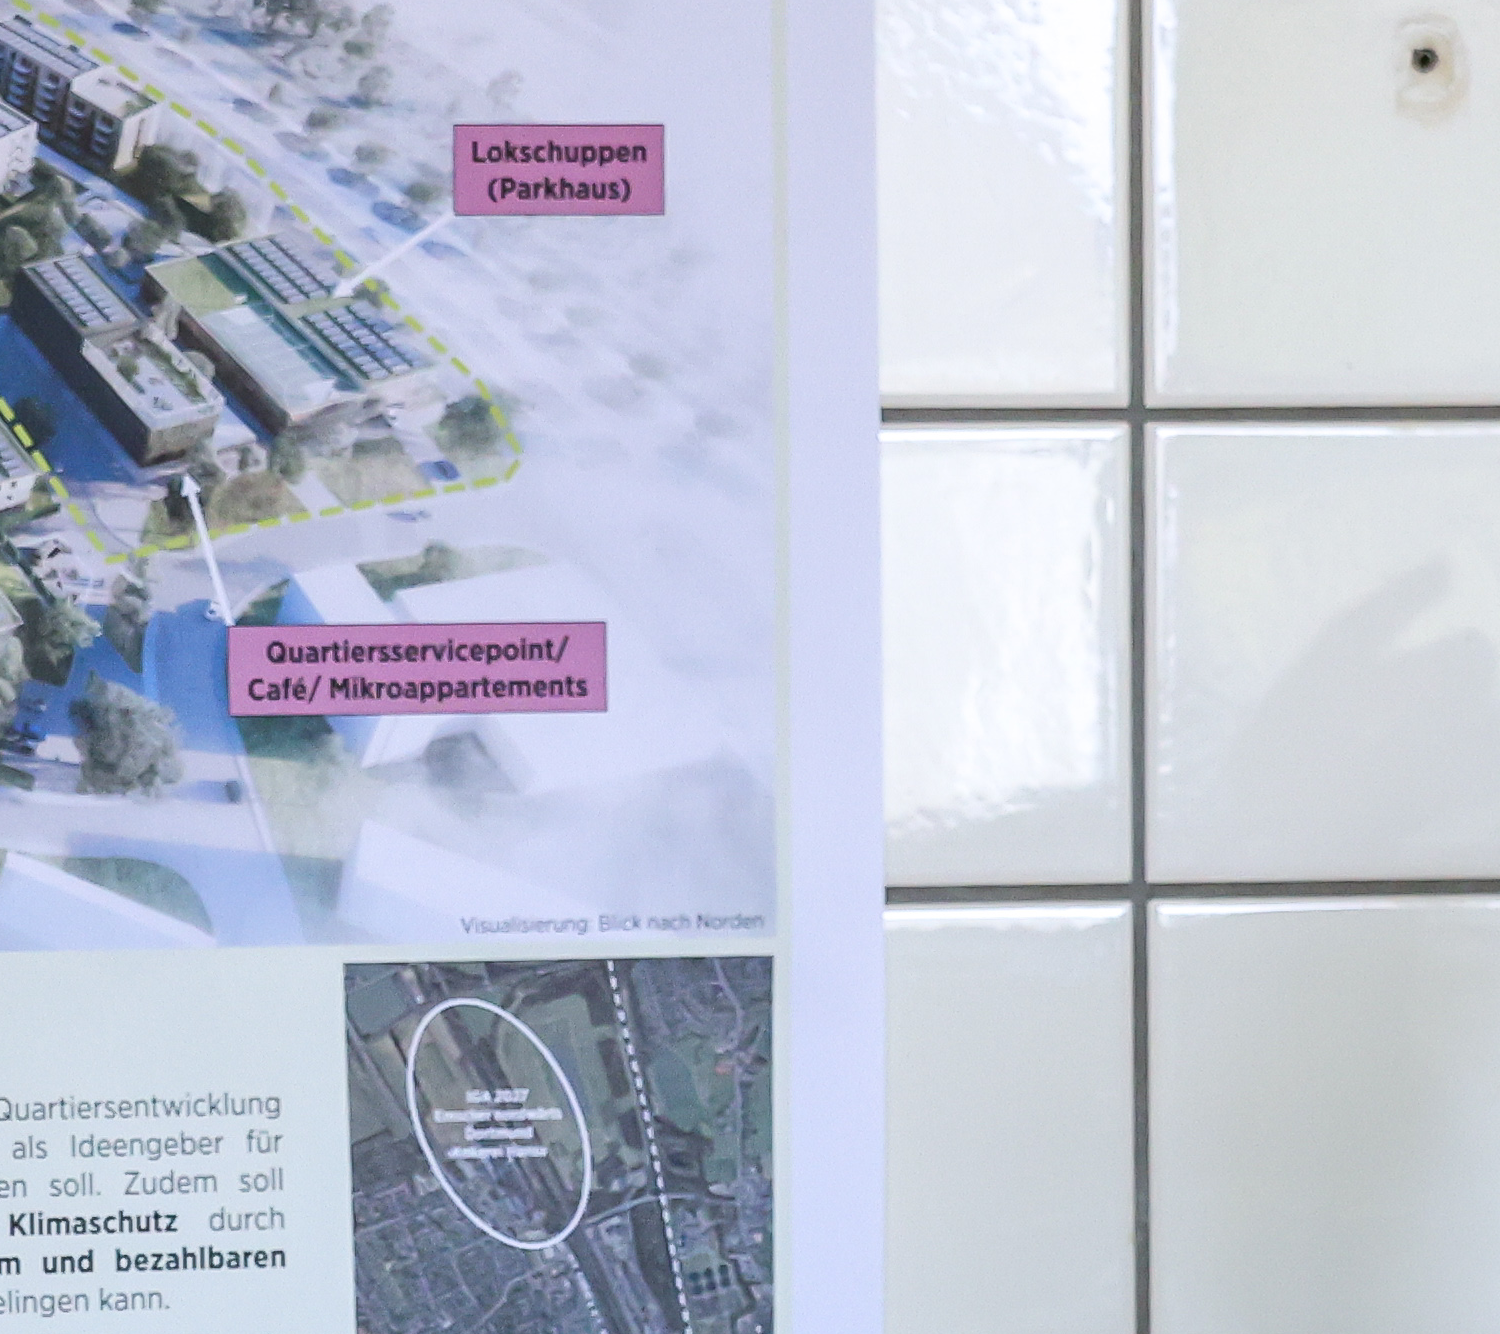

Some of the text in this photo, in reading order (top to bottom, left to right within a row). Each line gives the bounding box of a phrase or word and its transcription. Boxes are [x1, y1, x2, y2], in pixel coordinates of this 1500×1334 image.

[471, 139, 647, 168] Lokschuppen
[487, 176, 632, 204] (Parkhaus)
[266, 635, 570, 666] Quartiersservicepoint/
[247, 674, 588, 704] Café/ Mikroappartements
